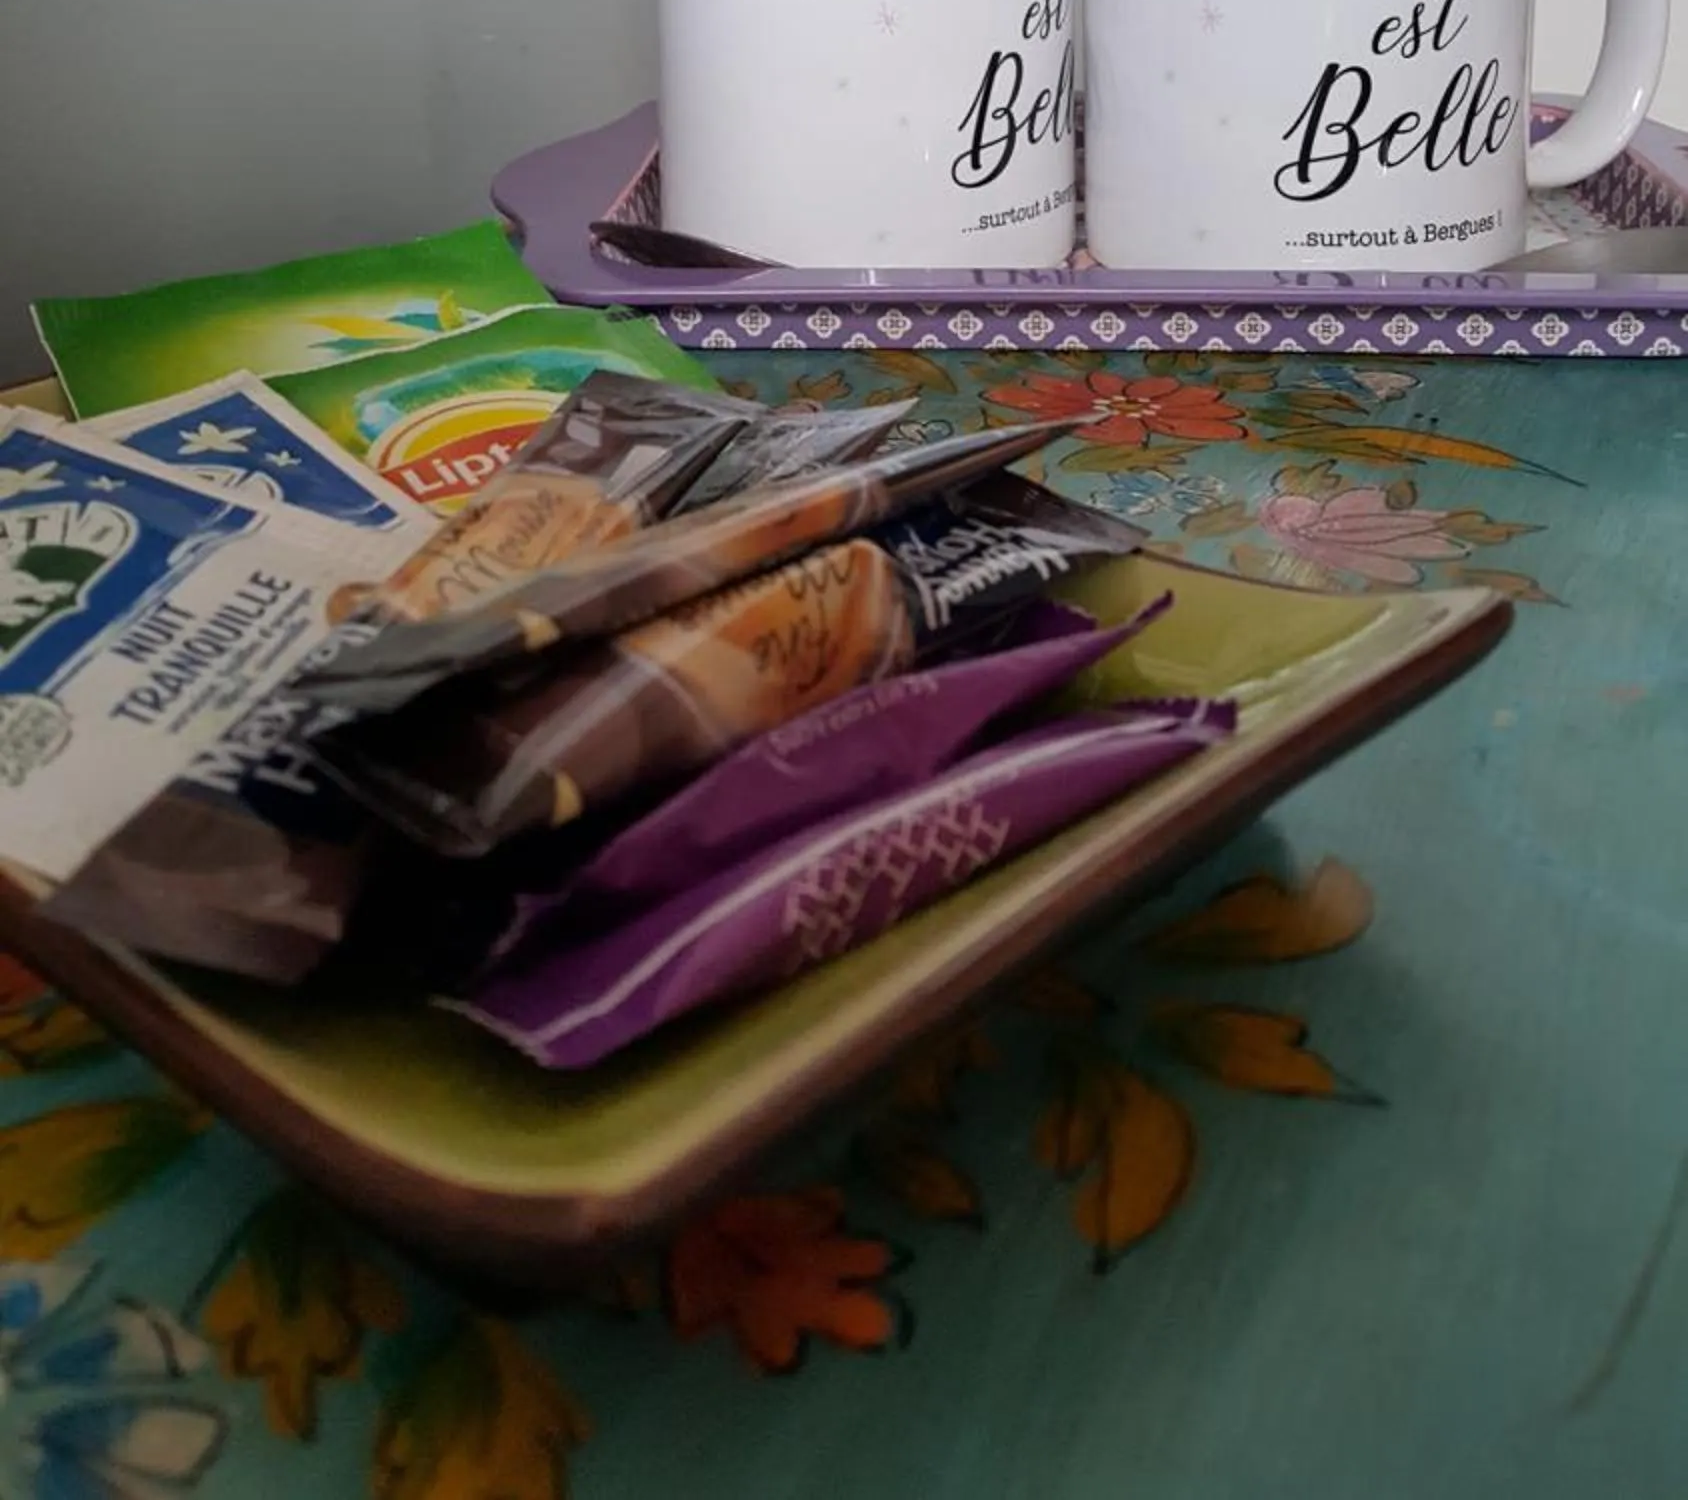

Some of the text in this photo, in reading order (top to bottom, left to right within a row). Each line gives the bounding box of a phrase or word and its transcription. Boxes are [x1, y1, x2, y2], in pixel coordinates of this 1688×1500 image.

[951, 40, 1074, 189] Bell
[1274, 58, 1518, 202] Belle
[1403, 225, 1419, 245] à
[1423, 214, 1495, 243] Bergues
[402, 441, 528, 495] Lipt
[109, 570, 292, 725] TRANQUILLE
[110, 601, 195, 664] NUIT
